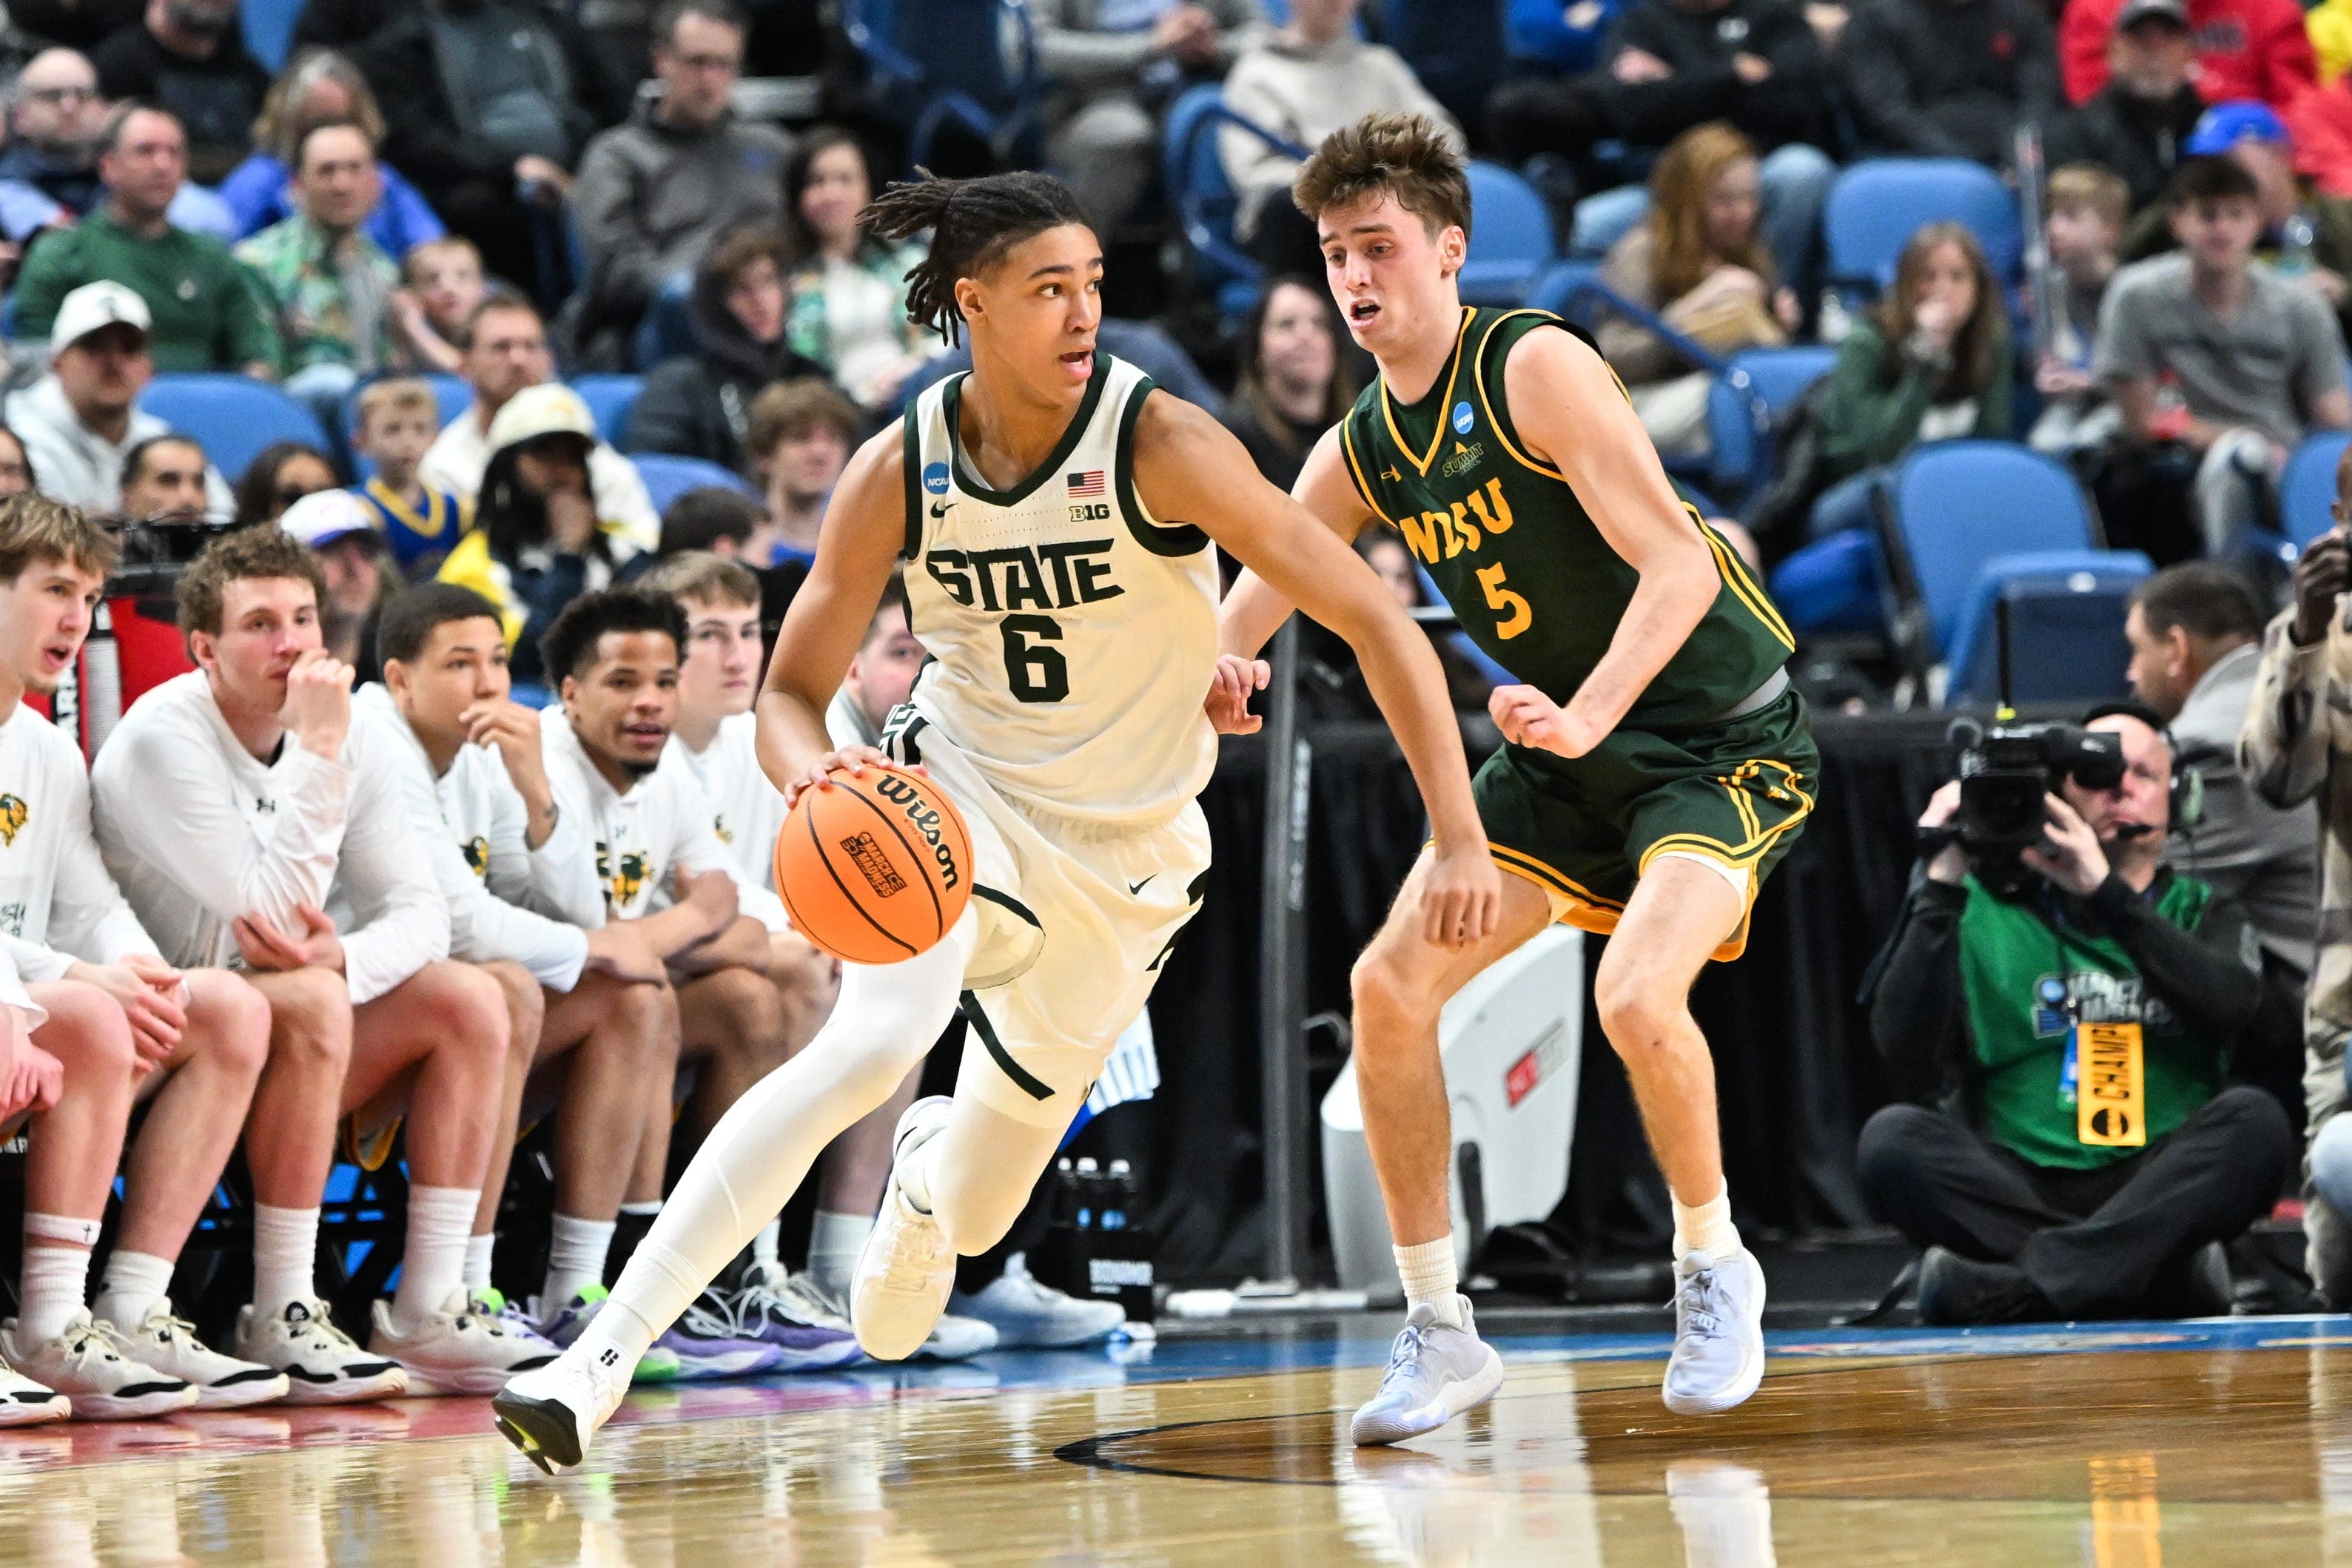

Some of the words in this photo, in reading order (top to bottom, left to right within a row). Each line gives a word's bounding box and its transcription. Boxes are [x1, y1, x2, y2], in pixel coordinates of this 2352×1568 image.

[1442, 443, 1484, 477] SUMMIT
[926, 538, 1125, 611] STATE
[1475, 562, 1532, 640] 5
[999, 613, 1069, 703] 6
[863, 842, 894, 877] MARCH
[876, 774, 958, 892] Wilson
[857, 852, 895, 896] MADNESS
